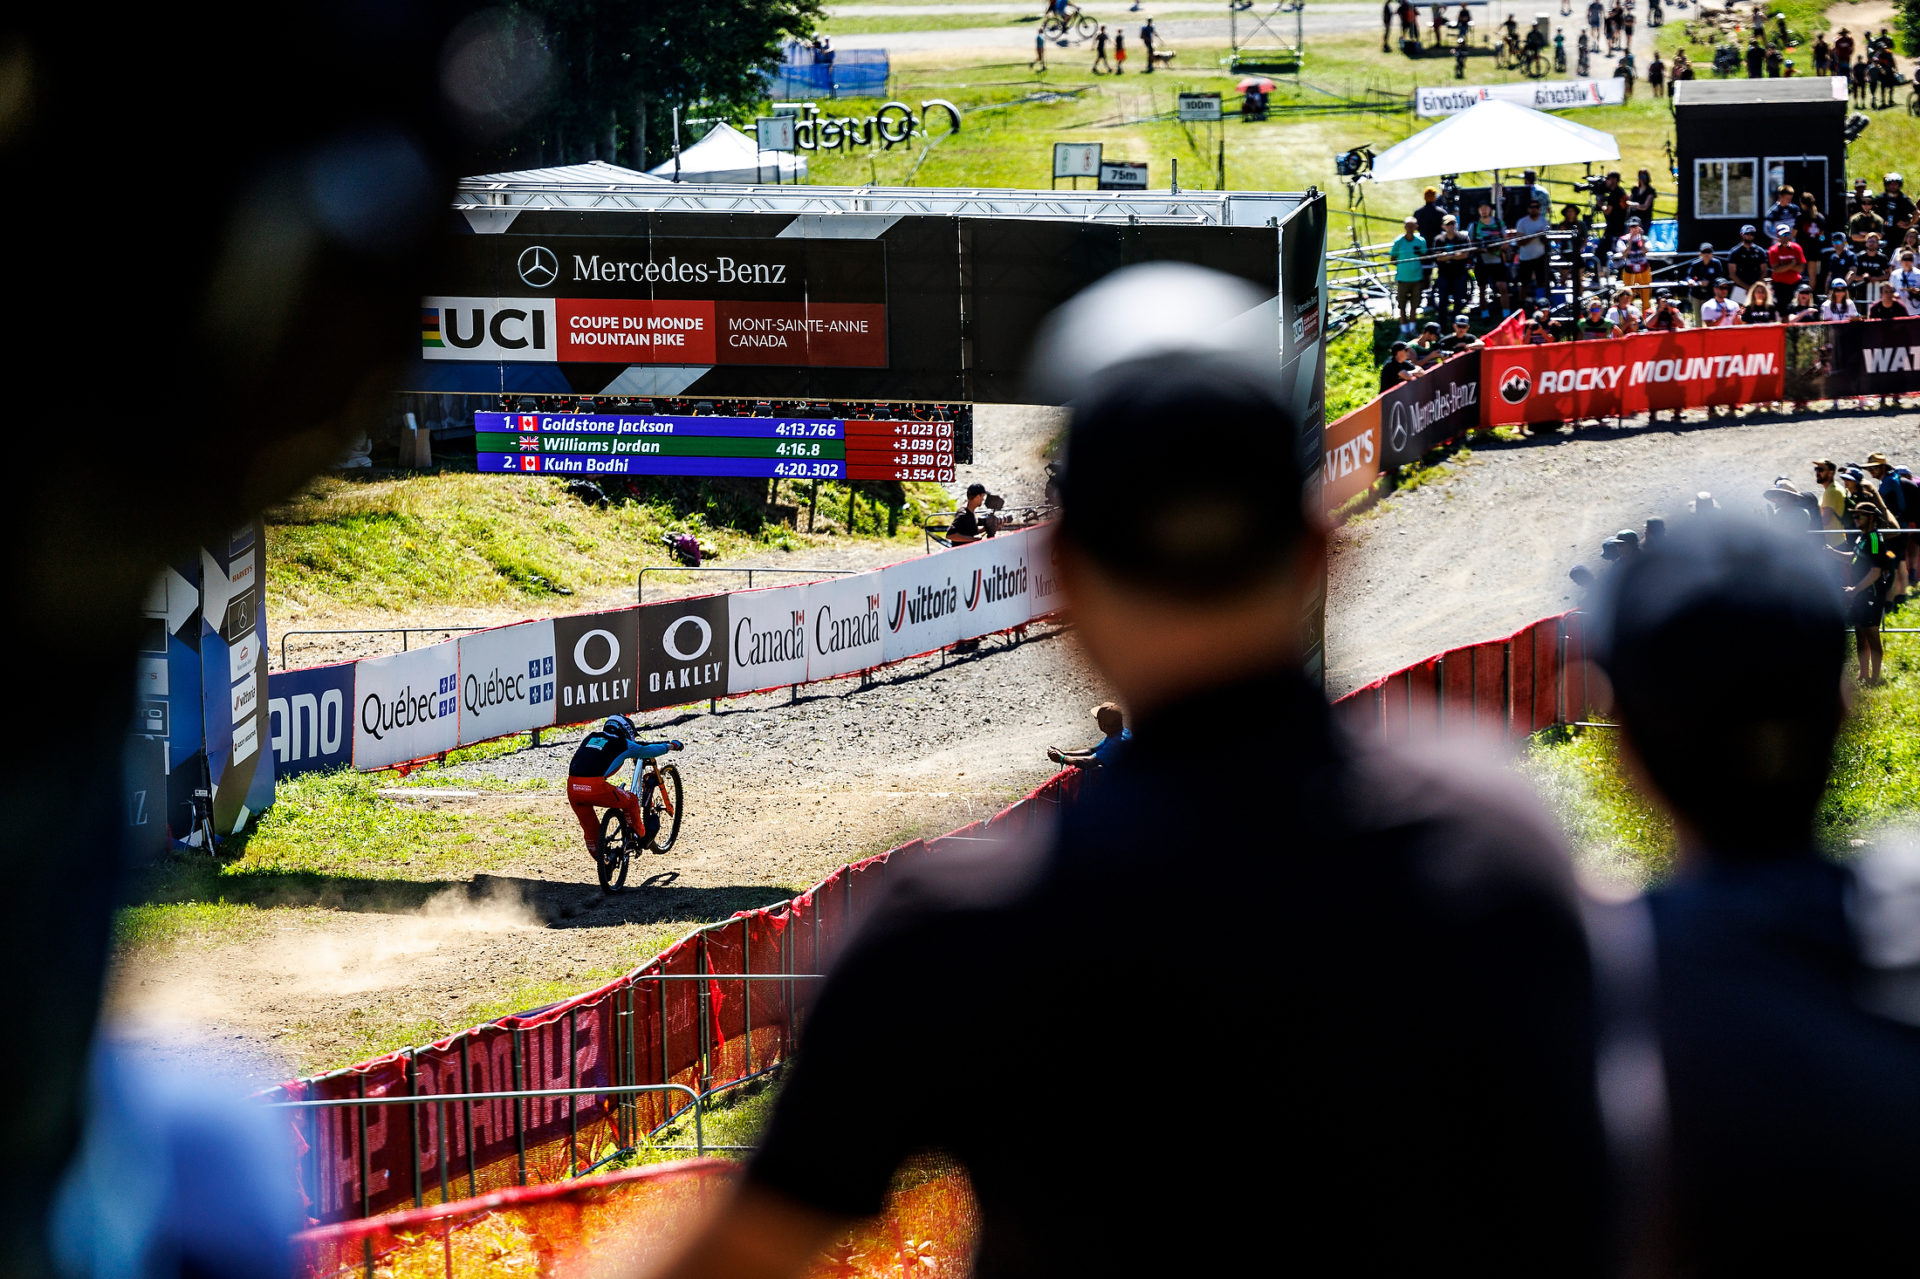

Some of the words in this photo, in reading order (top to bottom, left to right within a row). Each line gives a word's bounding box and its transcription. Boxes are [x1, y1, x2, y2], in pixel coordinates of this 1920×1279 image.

[1185, 100, 1214, 110] 100m
[1111, 169, 1138, 181] 75m
[572, 254, 786, 284] Mercedes-Benz
[444, 308, 545, 350] UCI
[570, 316, 619, 329] COUPE
[622, 317, 643, 330] DU
[647, 317, 703, 331] MONDE
[729, 317, 868, 333] MONT-SAINTE-ANNE
[570, 332, 650, 345] MOUNTAIN
[653, 333, 685, 346] BIKE
[729, 334, 787, 348] CANADA
[1863, 347, 1920, 373] WAT
[1538, 364, 1625, 394] ROCKY
[1408, 381, 1477, 437] Mercedes-Benz
[503, 416, 514, 429] 1.
[542, 417, 614, 432] Goldstone
[617, 418, 673, 434] Jackson
[775, 422, 836, 437] 4:13.766
[894, 423, 933, 436] +1.023
[935, 423, 952, 438] (3)
[543, 437, 609, 452] Williams
[611, 438, 660, 454] Jordan
[776, 442, 820, 456] 4:16.8
[893, 438, 934, 451] +3.039
[935, 439, 952, 453] (2)
[503, 456, 516, 469] 2.
[544, 457, 583, 472] Kuhn
[586, 457, 629, 472] Bodhi
[774, 462, 839, 478] 4:20.302
[893, 453, 934, 466] +3.390
[936, 453, 953, 467] (2)
[894, 468, 935, 481] +3.554
[937, 468, 954, 482] (2)
[983, 557, 1028, 604] vittoria
[907, 577, 957, 625] vittoria
[815, 595, 880, 656] Canada
[734, 610, 804, 668] Canada
[649, 662, 722, 692] OAKLEY
[464, 668, 526, 717] Québec
[563, 678, 630, 707] OAKLEY
[361, 685, 437, 741] Québec
